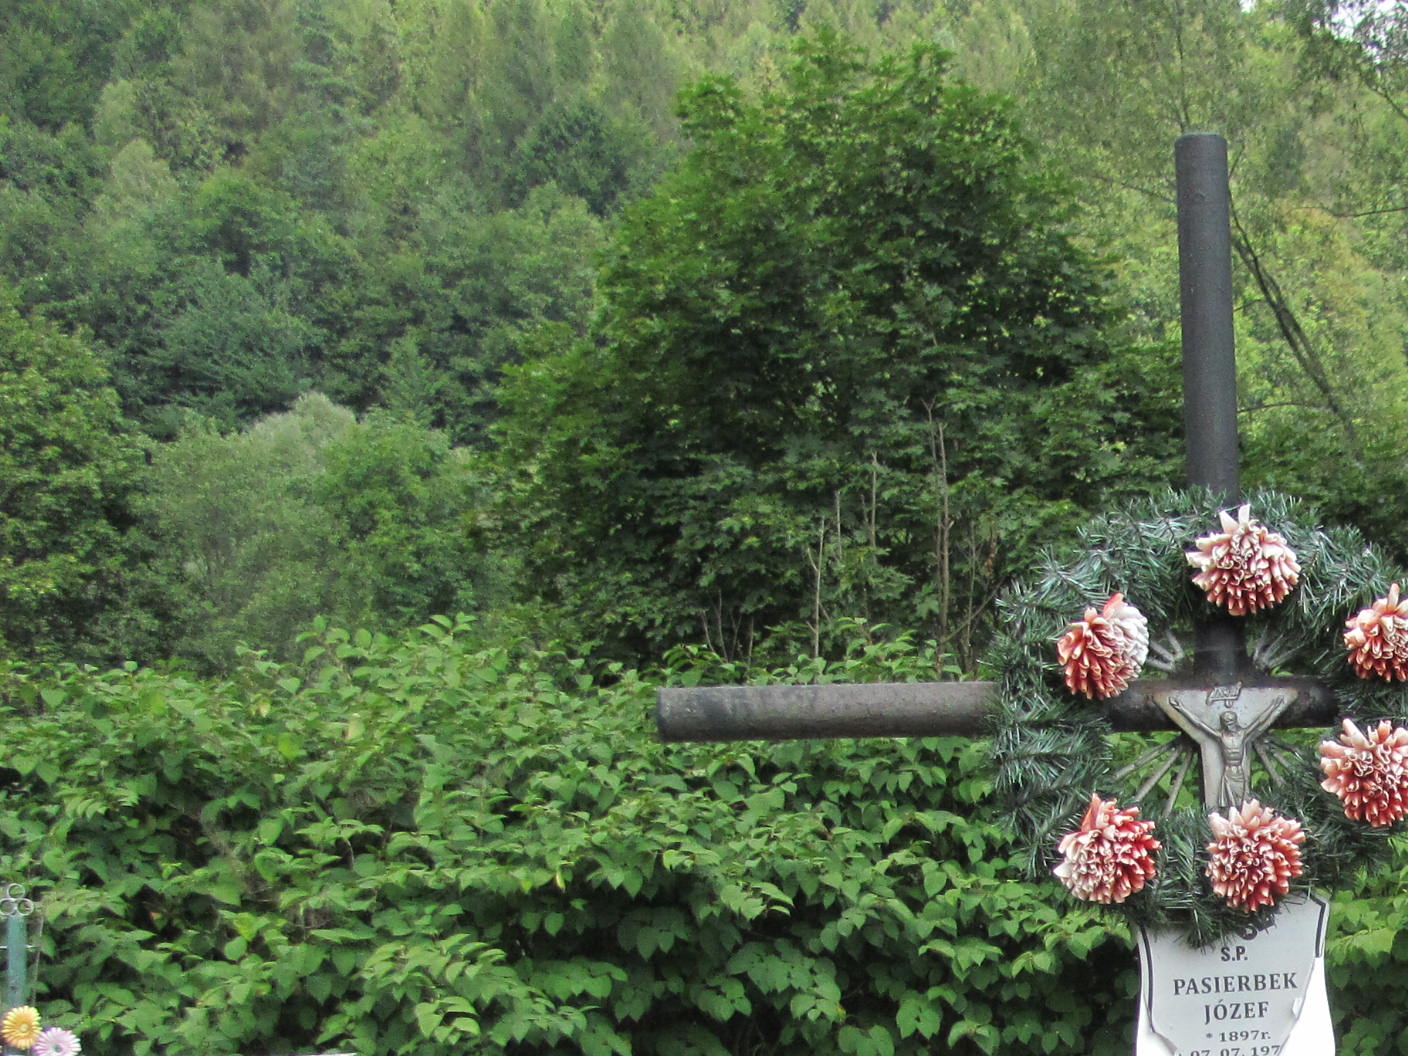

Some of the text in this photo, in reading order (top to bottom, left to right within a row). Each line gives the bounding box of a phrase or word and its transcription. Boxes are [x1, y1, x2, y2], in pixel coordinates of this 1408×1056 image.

[1174, 972, 1298, 996] PASIERBEK
[1204, 999, 1270, 1025] JÓZEF
[1219, 1030, 1271, 1042] 1897r.
[1251, 1045, 1280, 1056] 197
